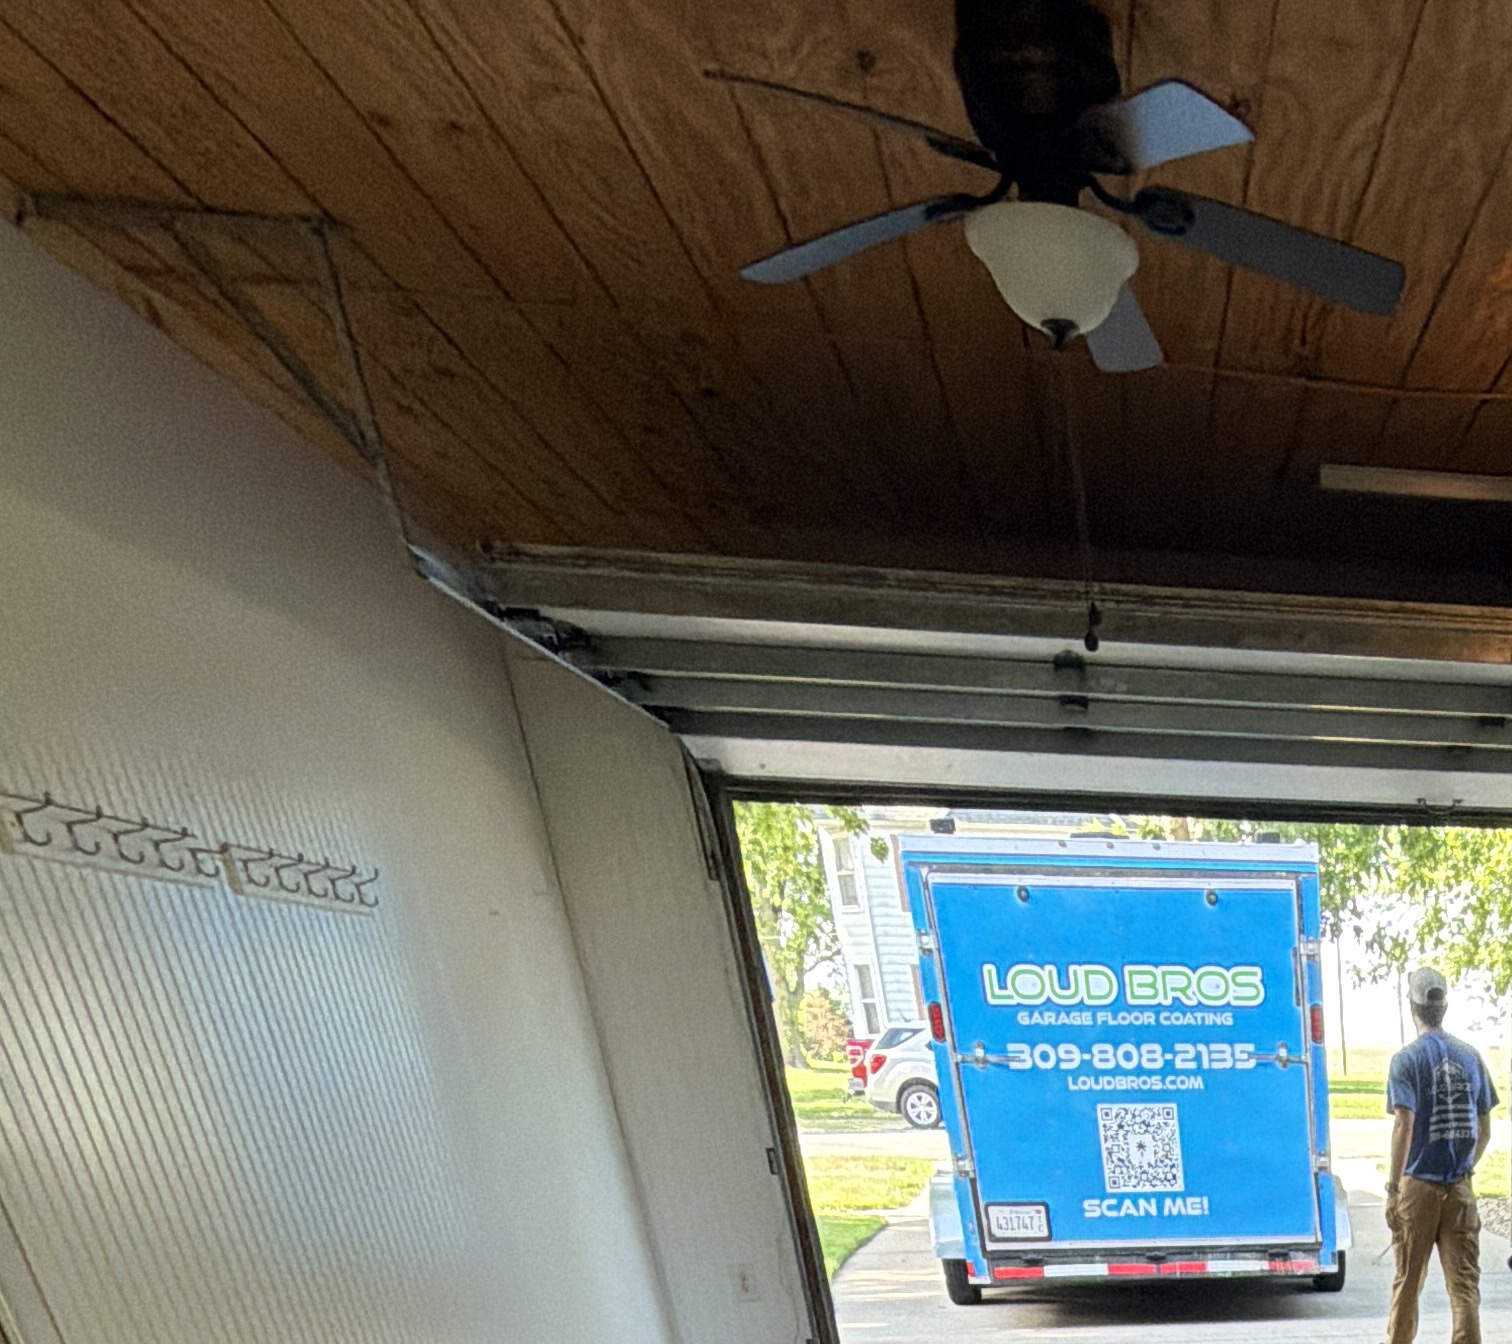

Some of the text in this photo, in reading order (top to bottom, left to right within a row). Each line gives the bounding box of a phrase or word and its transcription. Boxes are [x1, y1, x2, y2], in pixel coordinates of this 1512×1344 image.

[982, 964, 1265, 1006] LOUD BROS
[1017, 1011, 1233, 1026] GARAGE FLOOR COATING
[1006, 1043, 1257, 1070] 309-808-2135
[1067, 1075, 1204, 1091] LOUDBROS.COM
[1083, 1196, 1209, 1218] SCAN ME!
[996, 1215, 1034, 1231] 431747
